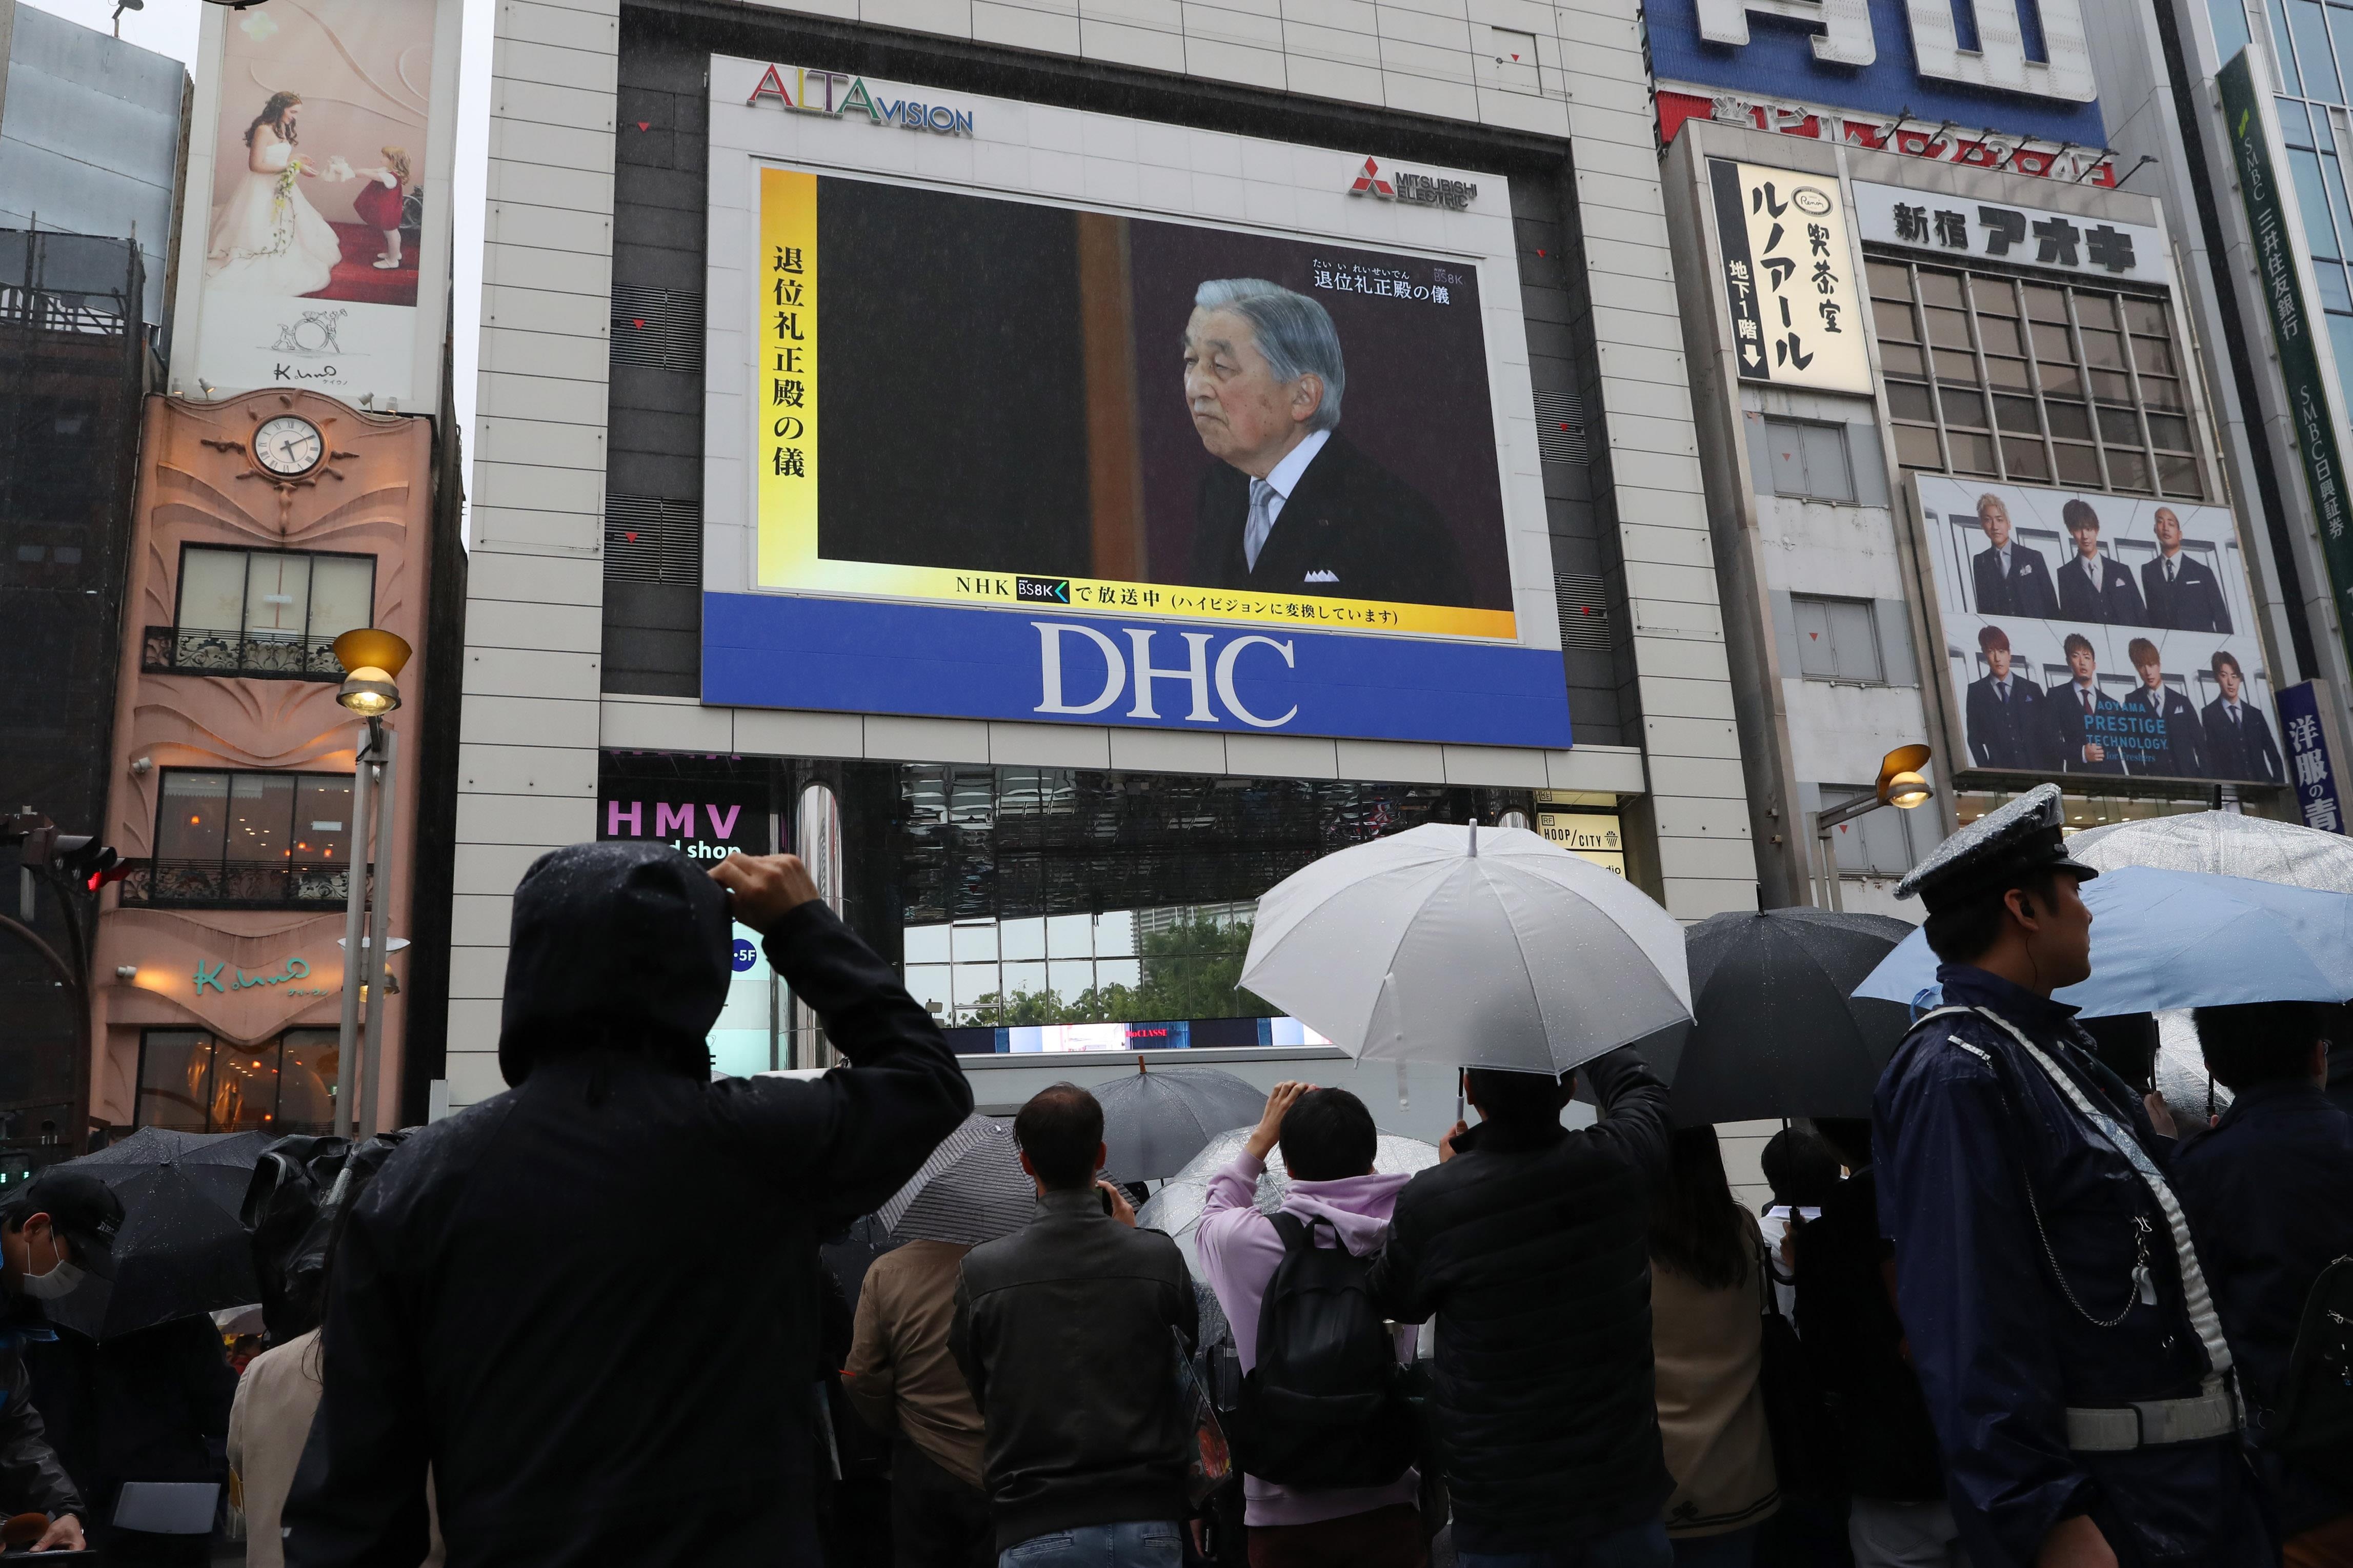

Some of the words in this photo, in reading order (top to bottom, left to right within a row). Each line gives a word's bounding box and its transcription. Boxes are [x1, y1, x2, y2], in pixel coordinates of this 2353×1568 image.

[1395, 172, 1477, 197] MITSUBISHI
[1397, 186, 1469, 208] ELECTRIC
[1893, 201, 2136, 272] 新宿アオキ
[1314, 270, 1450, 305] 退位礼正殿の儀
[1434, 272, 1463, 285] BS8K
[1752, 181, 1814, 371] ルノアール
[1807, 222, 1841, 333] 喫茶室
[1729, 260, 1758, 340] 地下1階
[773, 245, 806, 478] 退位礼正殿の儀
[956, 577, 1010, 596] NHK
[1019, 583, 1053, 597] BS8K
[1031, 622, 1298, 727] DHC
[2097, 701, 2146, 713] AOYAMA
[2084, 715, 2166, 735] PRESTIGE
[607, 800, 741, 839] HMV
